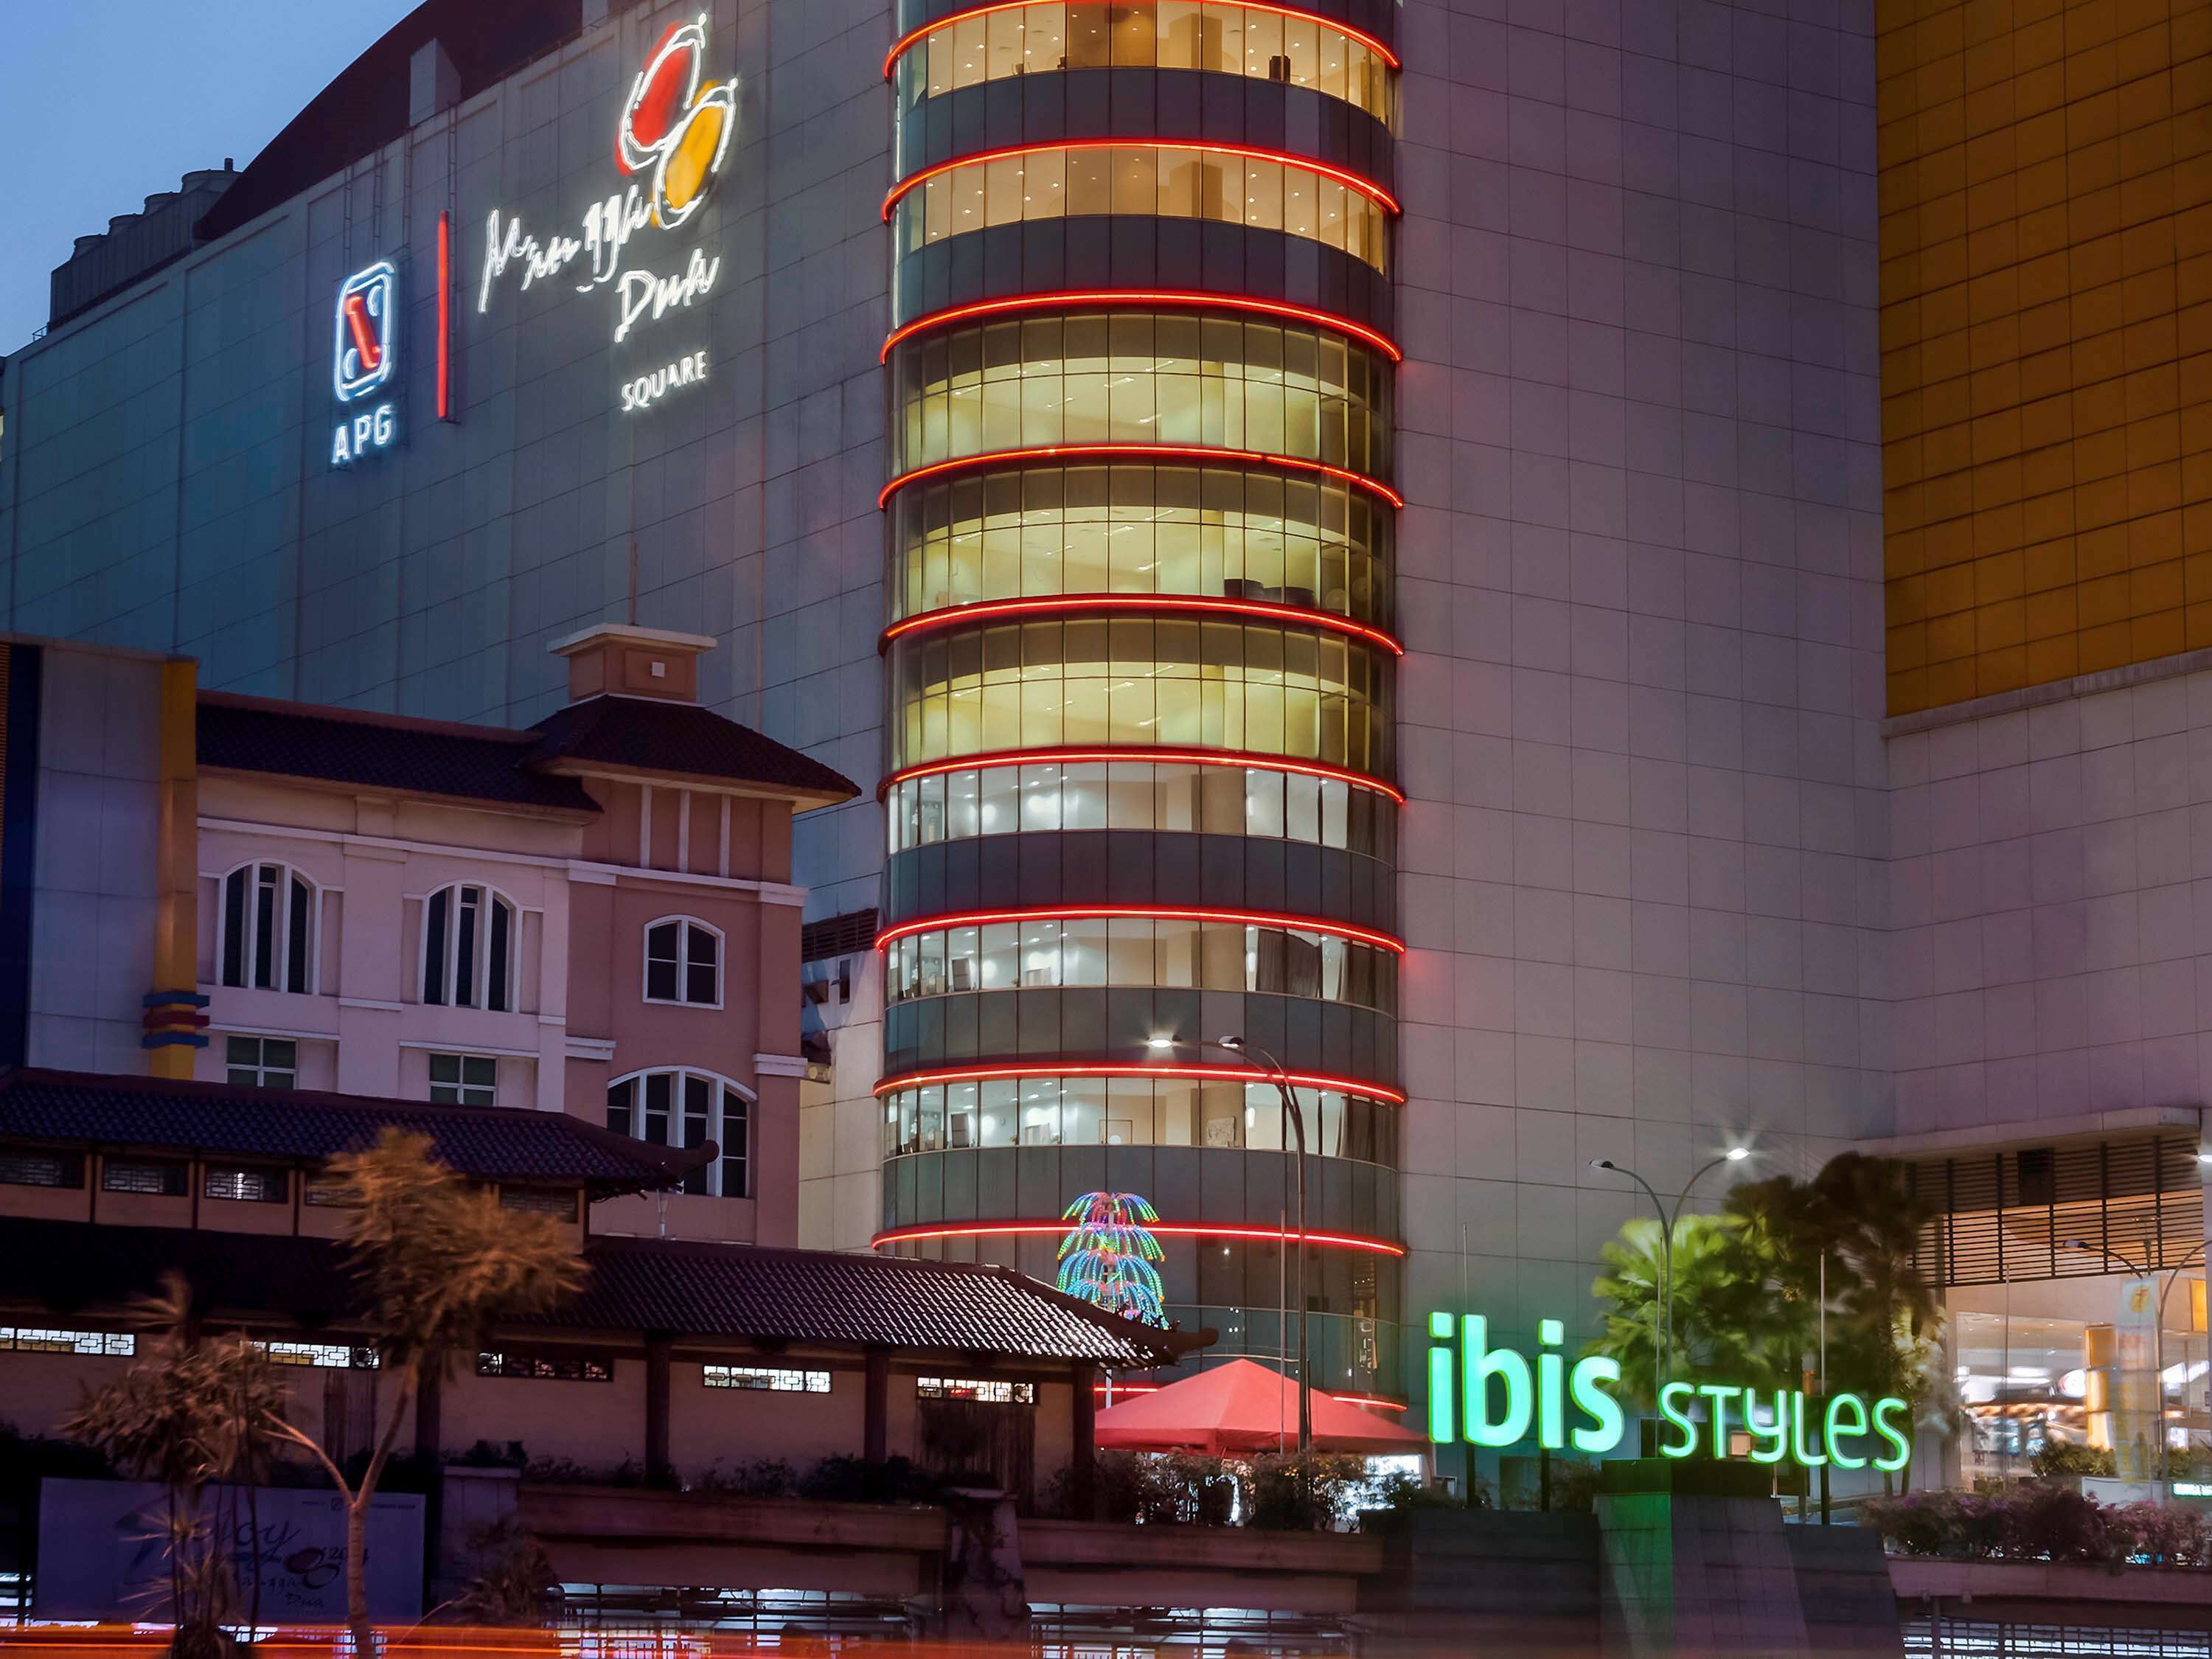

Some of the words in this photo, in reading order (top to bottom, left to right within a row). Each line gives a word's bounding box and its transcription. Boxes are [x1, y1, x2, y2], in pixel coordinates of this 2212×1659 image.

[620, 350, 708, 411] SQUARE
[331, 406, 394, 465] APG
[1428, 1311, 1624, 1453] ibis
